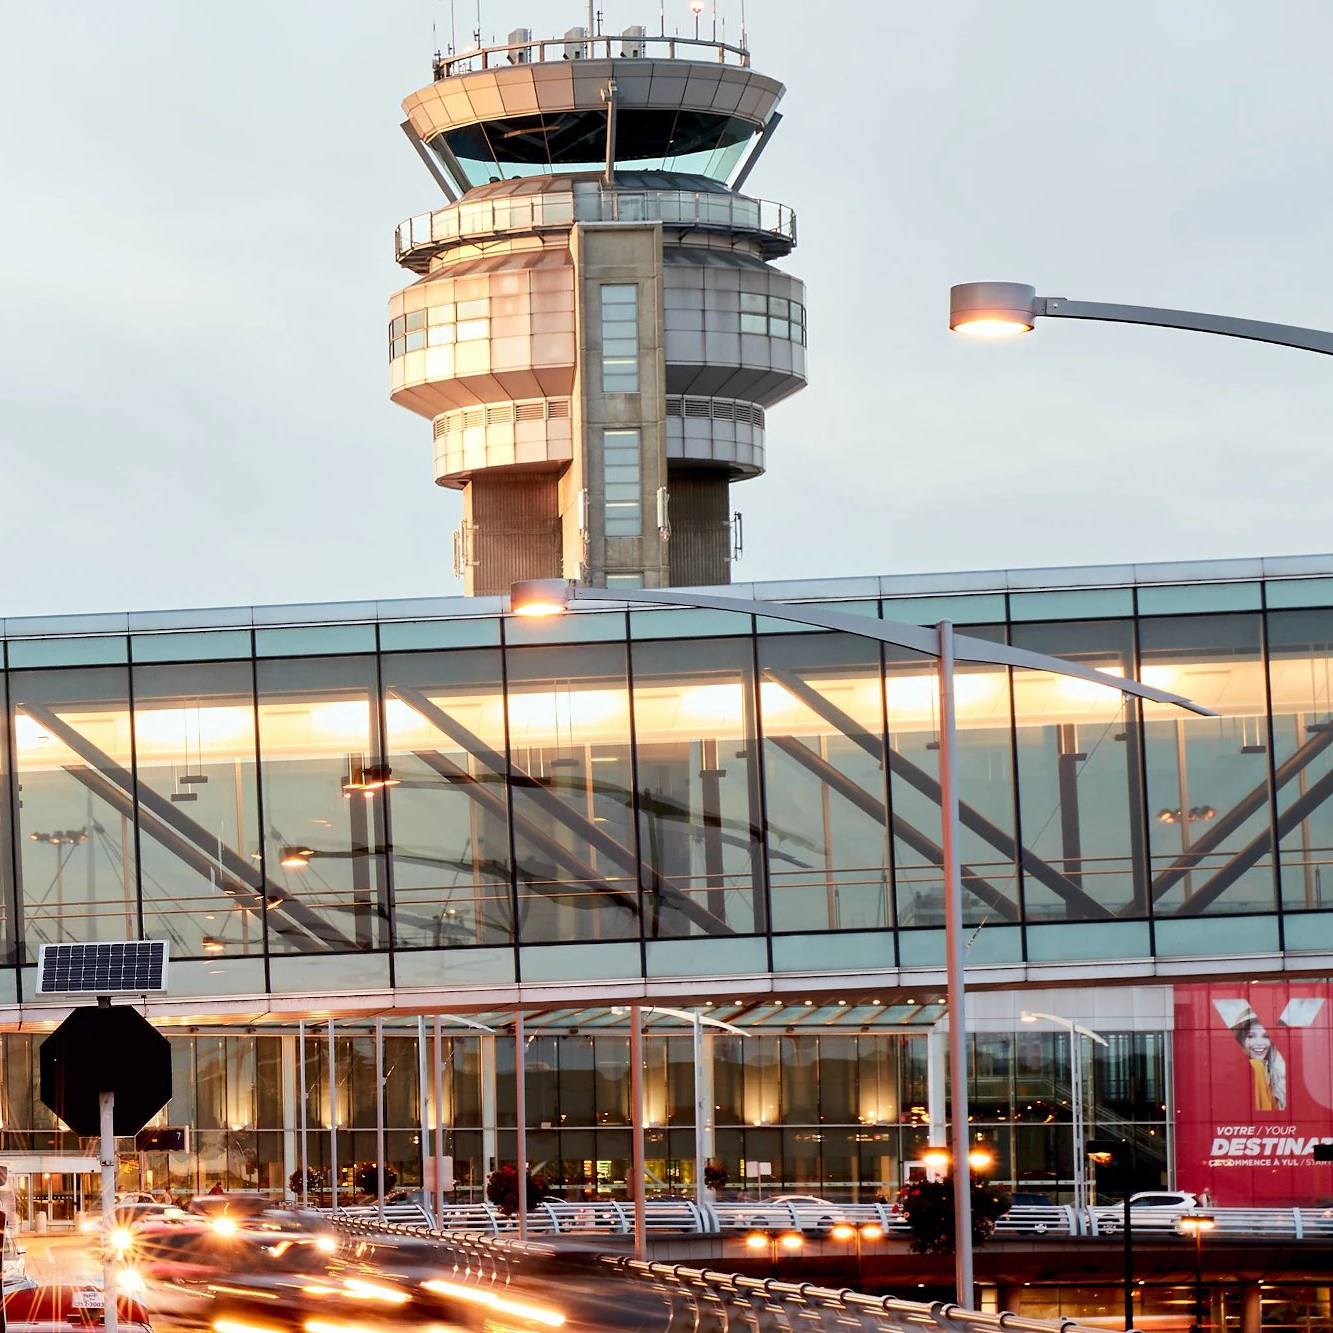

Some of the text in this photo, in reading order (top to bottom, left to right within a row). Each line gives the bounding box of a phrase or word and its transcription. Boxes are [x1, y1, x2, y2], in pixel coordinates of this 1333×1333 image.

[1216, 1126, 1255, 1135] VOTRE
[1265, 1125, 1297, 1135] YOUR
[176, 1132, 181, 1140] 7
